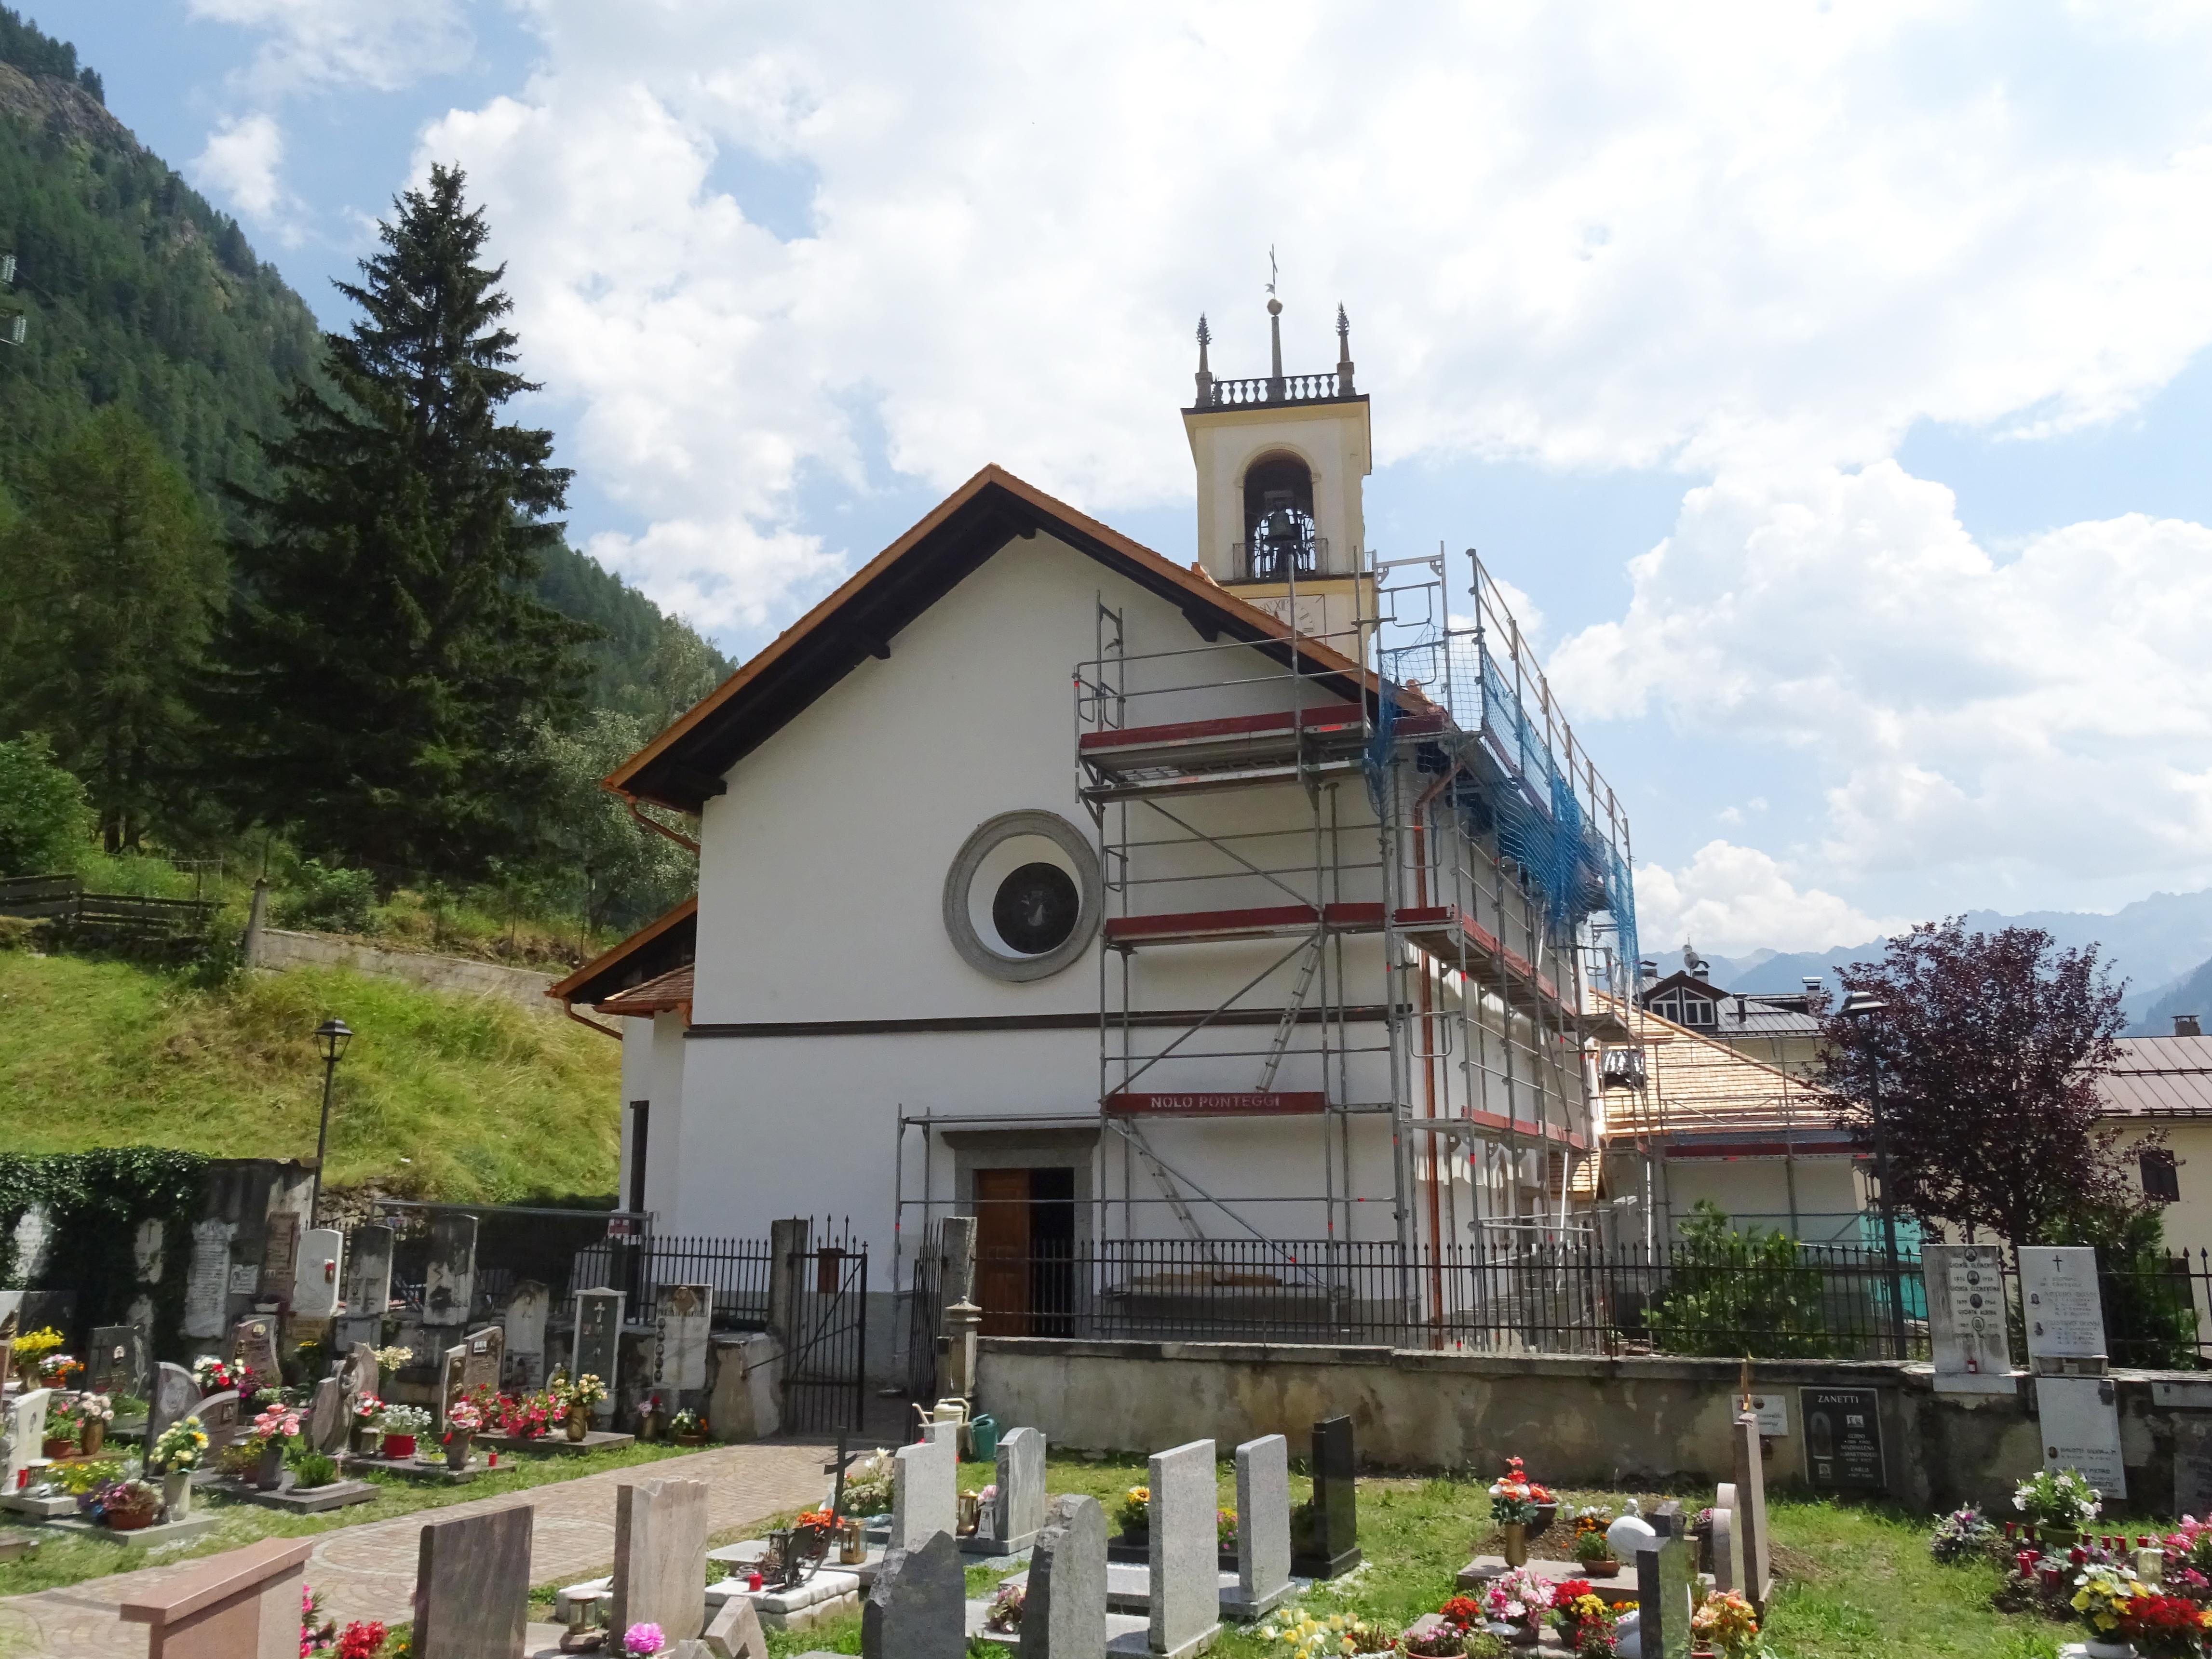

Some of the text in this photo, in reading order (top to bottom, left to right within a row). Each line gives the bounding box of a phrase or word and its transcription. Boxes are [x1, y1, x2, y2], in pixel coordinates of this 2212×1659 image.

[1150, 1096, 1280, 1108] NOLO PONTEGGI
[1817, 1395, 1859, 1404] ZANETTI
